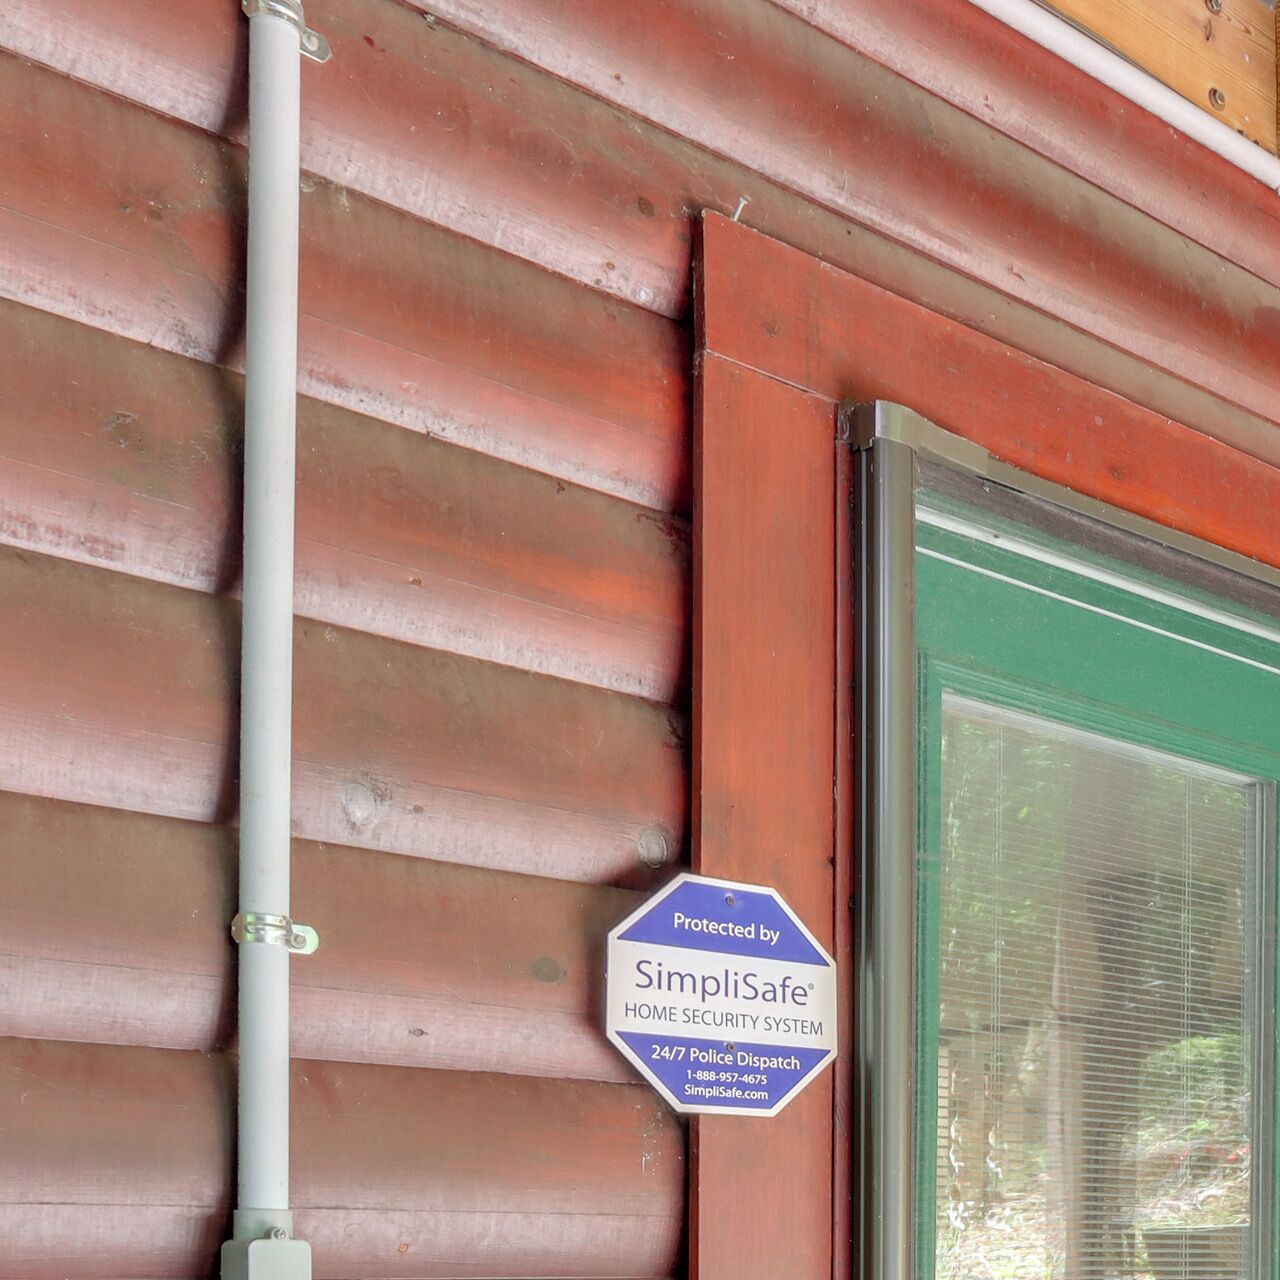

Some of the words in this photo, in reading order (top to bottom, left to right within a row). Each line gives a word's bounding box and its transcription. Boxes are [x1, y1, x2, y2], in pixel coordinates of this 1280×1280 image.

[674, 912, 756, 939] Protected
[759, 924, 782, 945] by
[624, 1002, 677, 1022] HOME
[682, 1008, 760, 1030] SECURITY
[763, 1016, 823, 1036] SYSTEM
[651, 1044, 686, 1062] 24/7
[689, 1048, 734, 1066] Police
[736, 1052, 801, 1072] Dispatch
[686, 1069, 768, 1086] 1-888-957-4675
[683, 1084, 769, 1102] SimpliSafe.com
